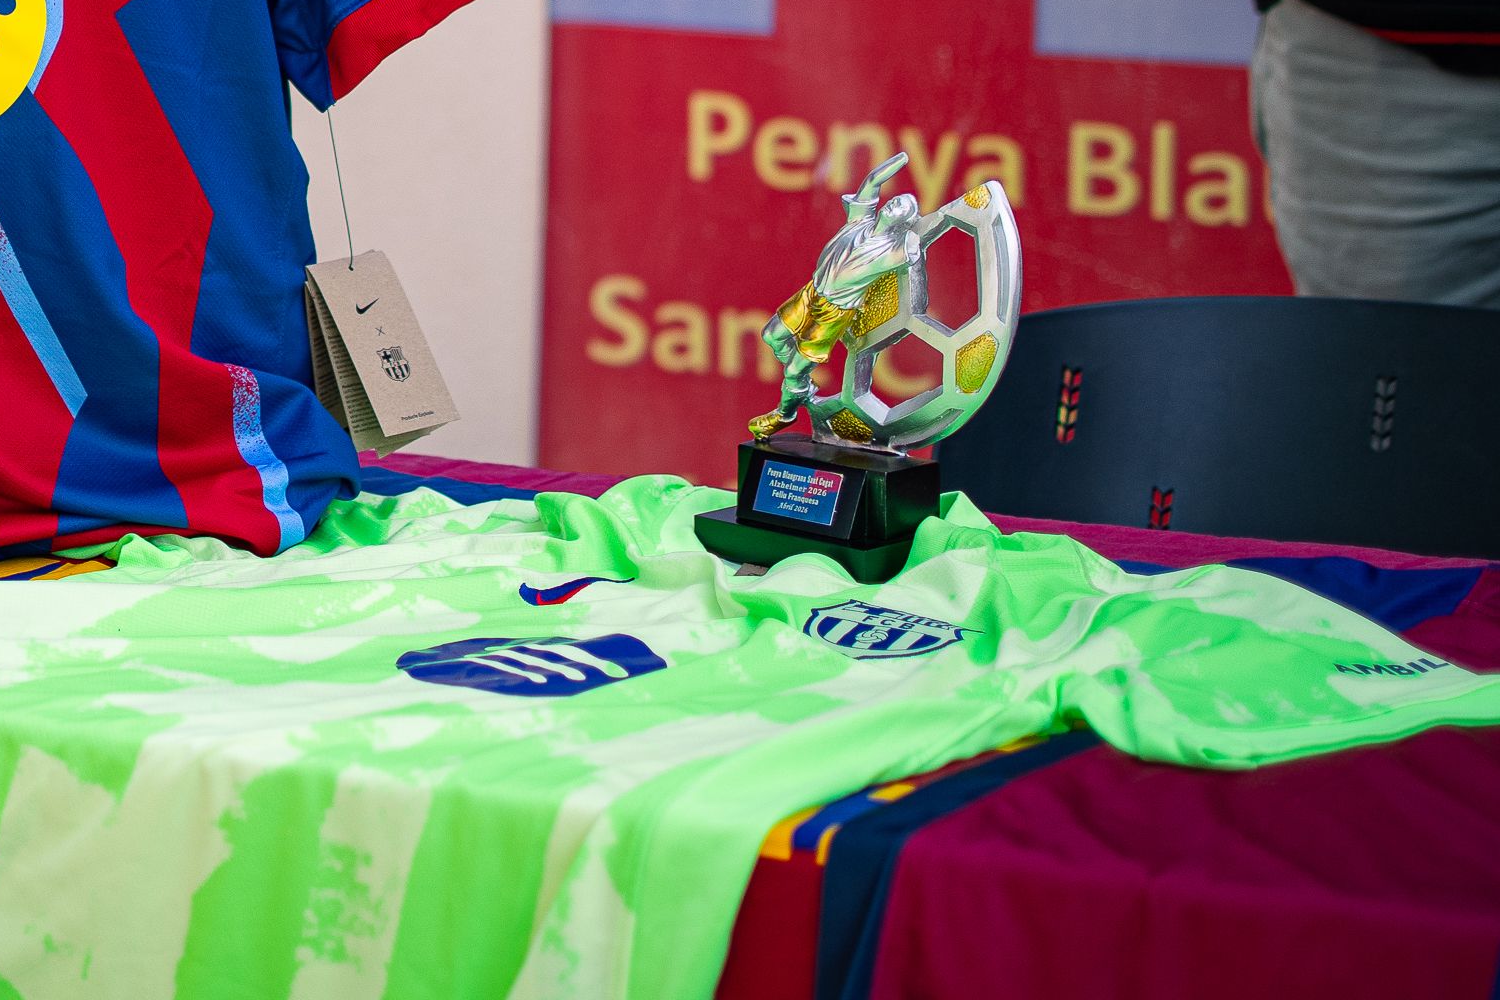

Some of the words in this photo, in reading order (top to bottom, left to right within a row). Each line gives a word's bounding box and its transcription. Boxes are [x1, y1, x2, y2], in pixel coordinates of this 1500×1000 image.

[686, 88, 1027, 212] Penya
[1066, 119, 1275, 227] Bla
[767, 467, 782, 479] Penya
[769, 479, 807, 493] Alzheimer
[808, 486, 827, 497] 2026
[788, 492, 819, 506] Franquesa
[777, 502, 795, 511] Abril
[794, 505, 808, 514] 2026
